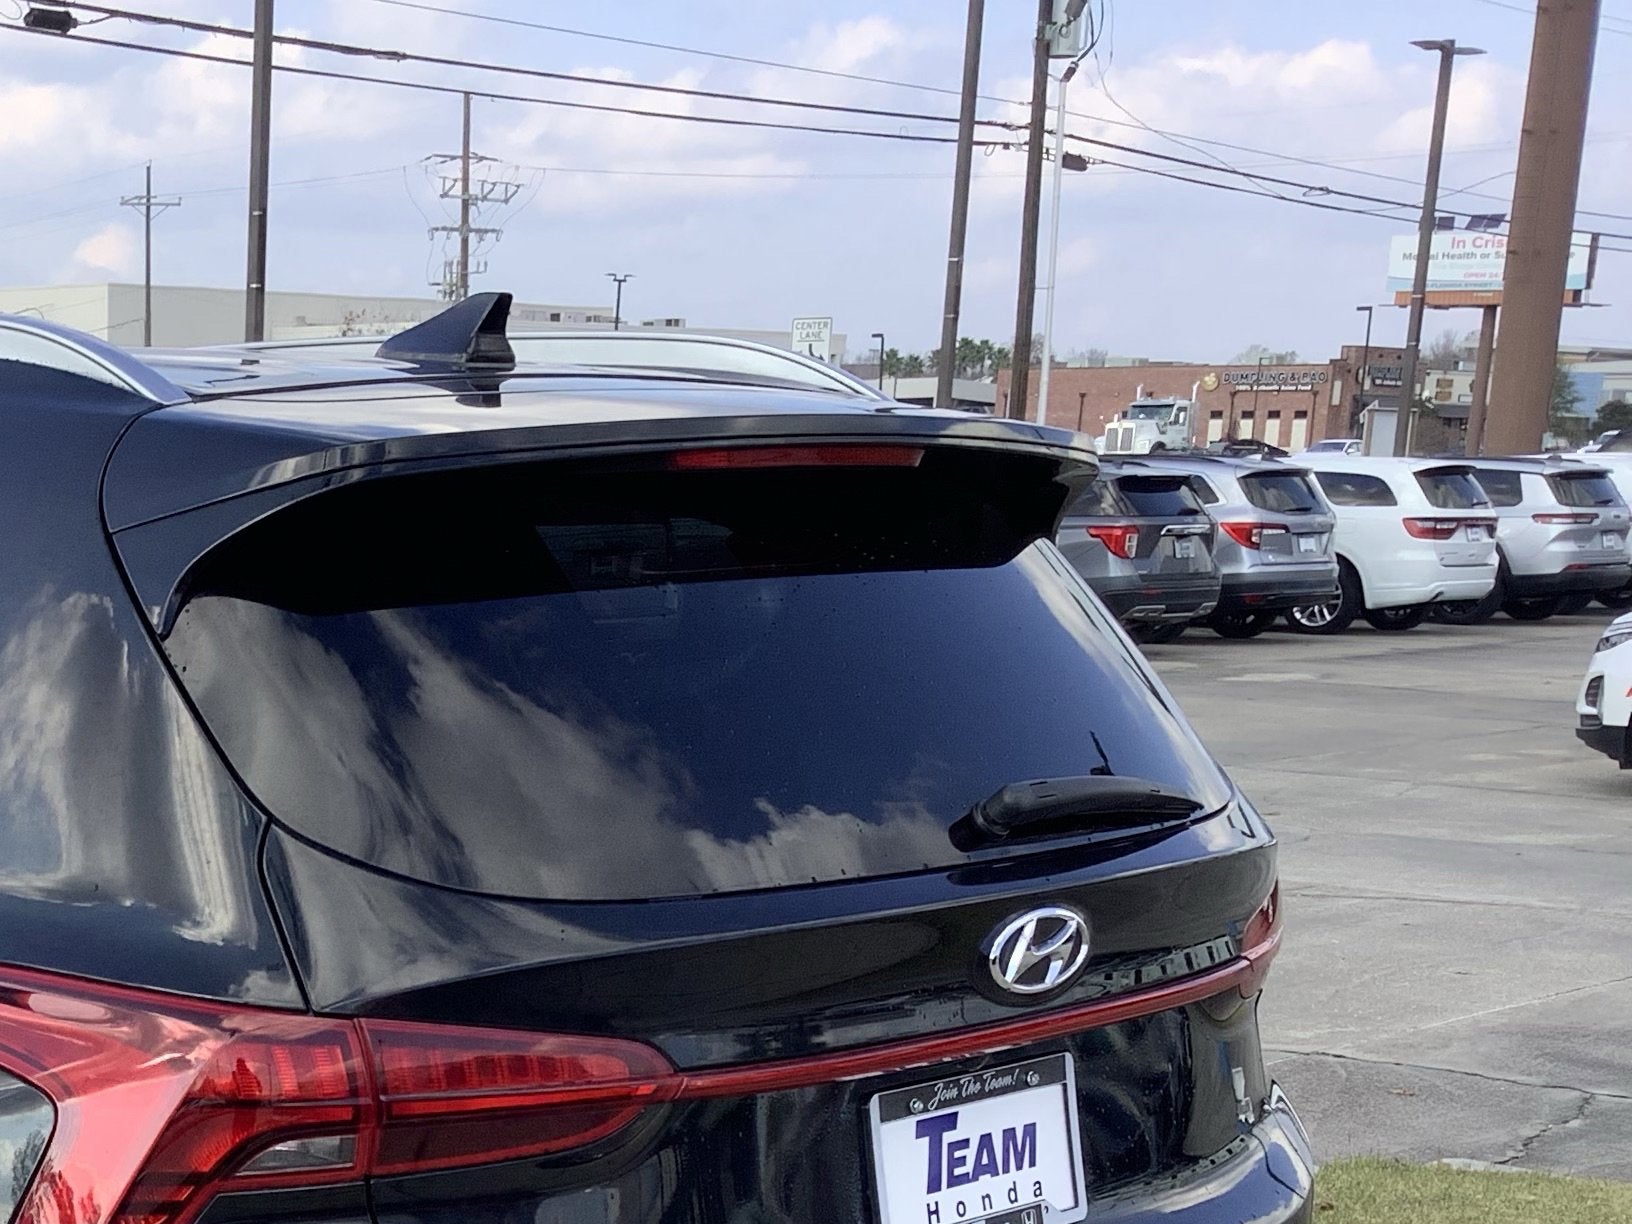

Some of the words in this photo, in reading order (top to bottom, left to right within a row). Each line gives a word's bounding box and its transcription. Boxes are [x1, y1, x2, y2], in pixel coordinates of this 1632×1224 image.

[1451, 236, 1466, 249] In
[1472, 235, 1505, 249] Cris
[1402, 251, 1439, 261] Meal
[1441, 251, 1477, 261] Health
[1479, 252, 1491, 260] or
[795, 321, 829, 330] CENTER
[800, 330, 823, 340] LANE
[1223, 371, 1286, 384] DUMPLING
[1301, 371, 1328, 383] BAO
[928, 1083, 959, 1110] Join
[959, 1073, 982, 1098] The
[983, 1069, 1019, 1092] Team!
[915, 1111, 1037, 1194] TEAM
